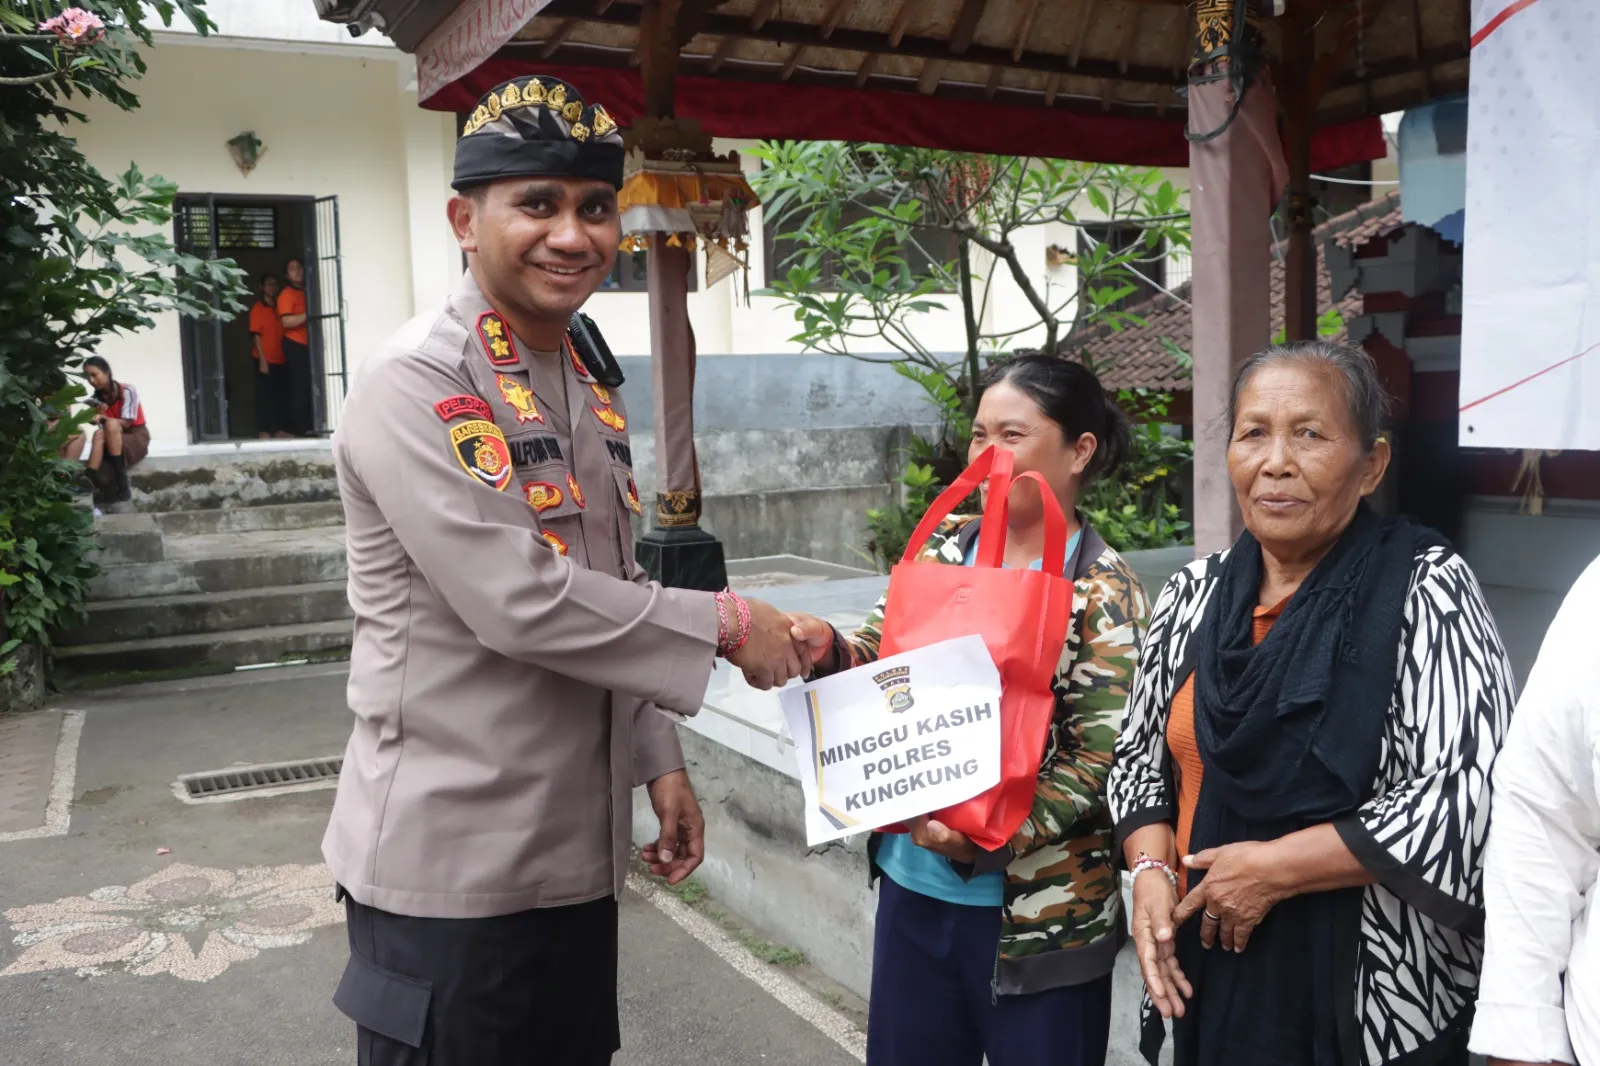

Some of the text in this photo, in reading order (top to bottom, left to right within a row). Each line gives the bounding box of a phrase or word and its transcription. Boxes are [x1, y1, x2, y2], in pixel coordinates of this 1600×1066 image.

[819, 702, 993, 767] MINGGU KASIH
[863, 739, 953, 780] POLRES
[845, 758, 979, 812] KUNGKUNG
